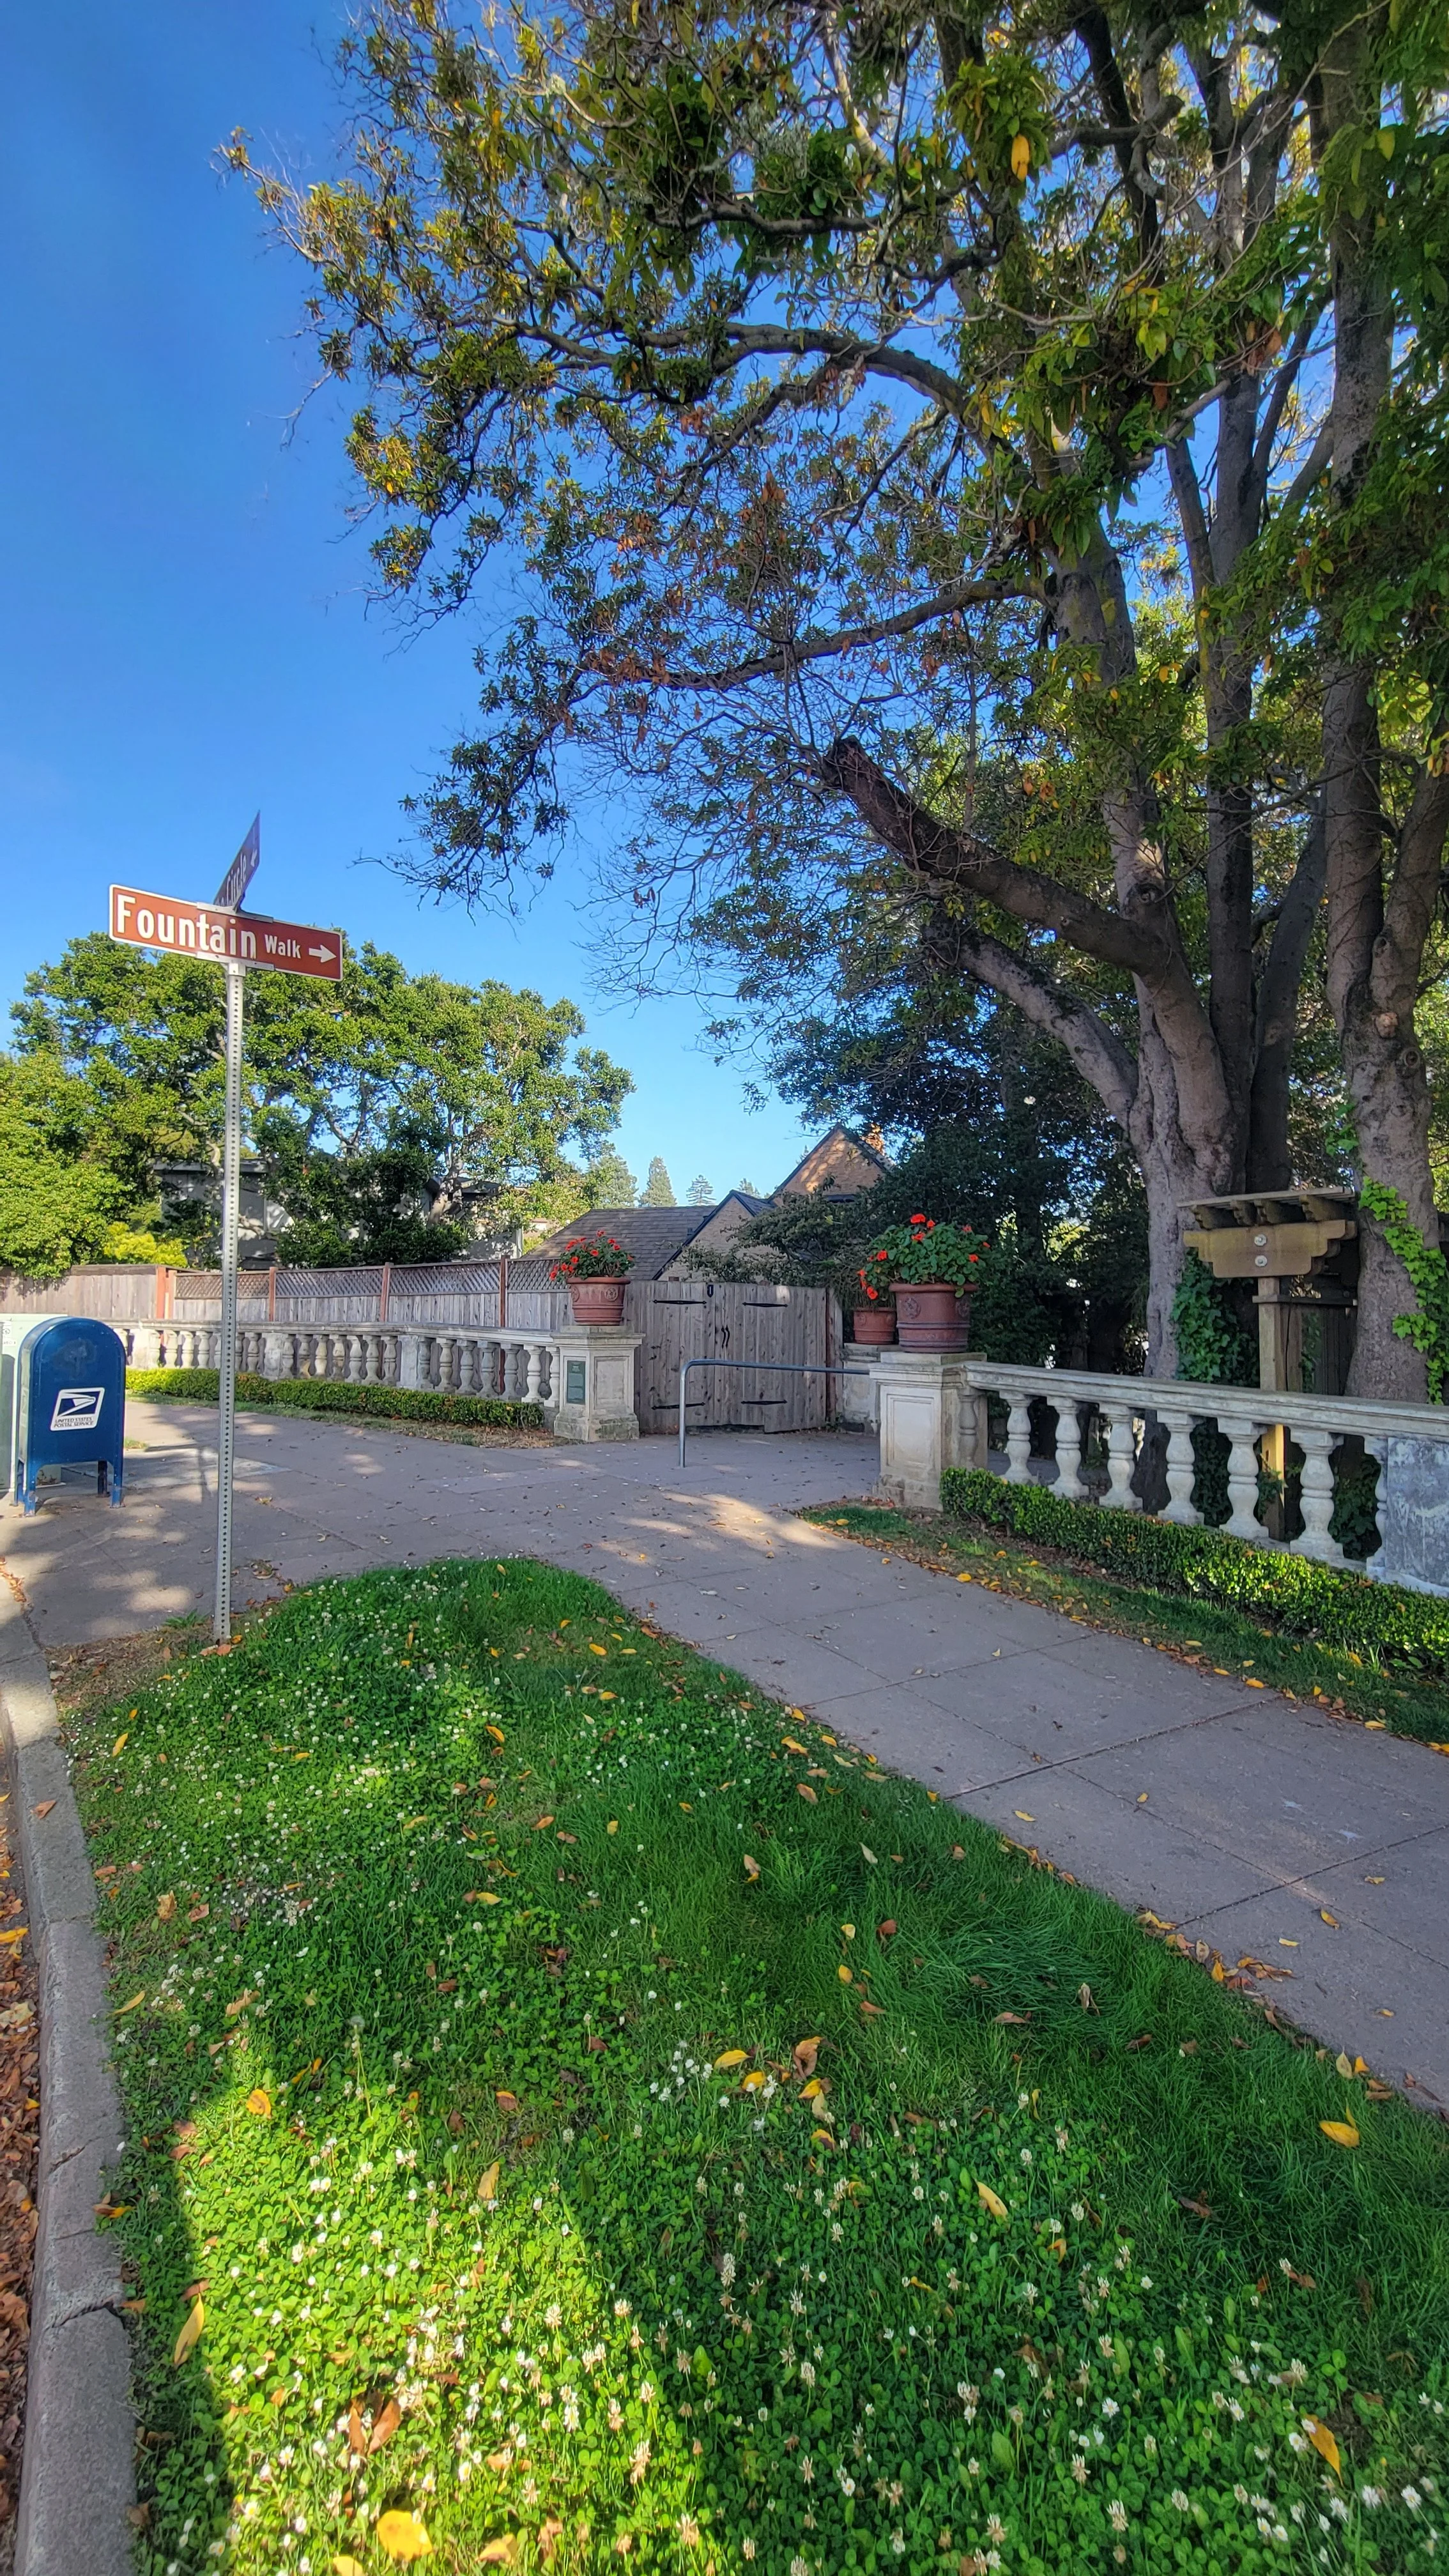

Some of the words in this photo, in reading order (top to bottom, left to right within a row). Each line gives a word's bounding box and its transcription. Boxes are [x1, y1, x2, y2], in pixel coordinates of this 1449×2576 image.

[226, 853, 247, 905] Circle
[117, 894, 256, 959] Fountain
[264, 934, 301, 959] Walk
